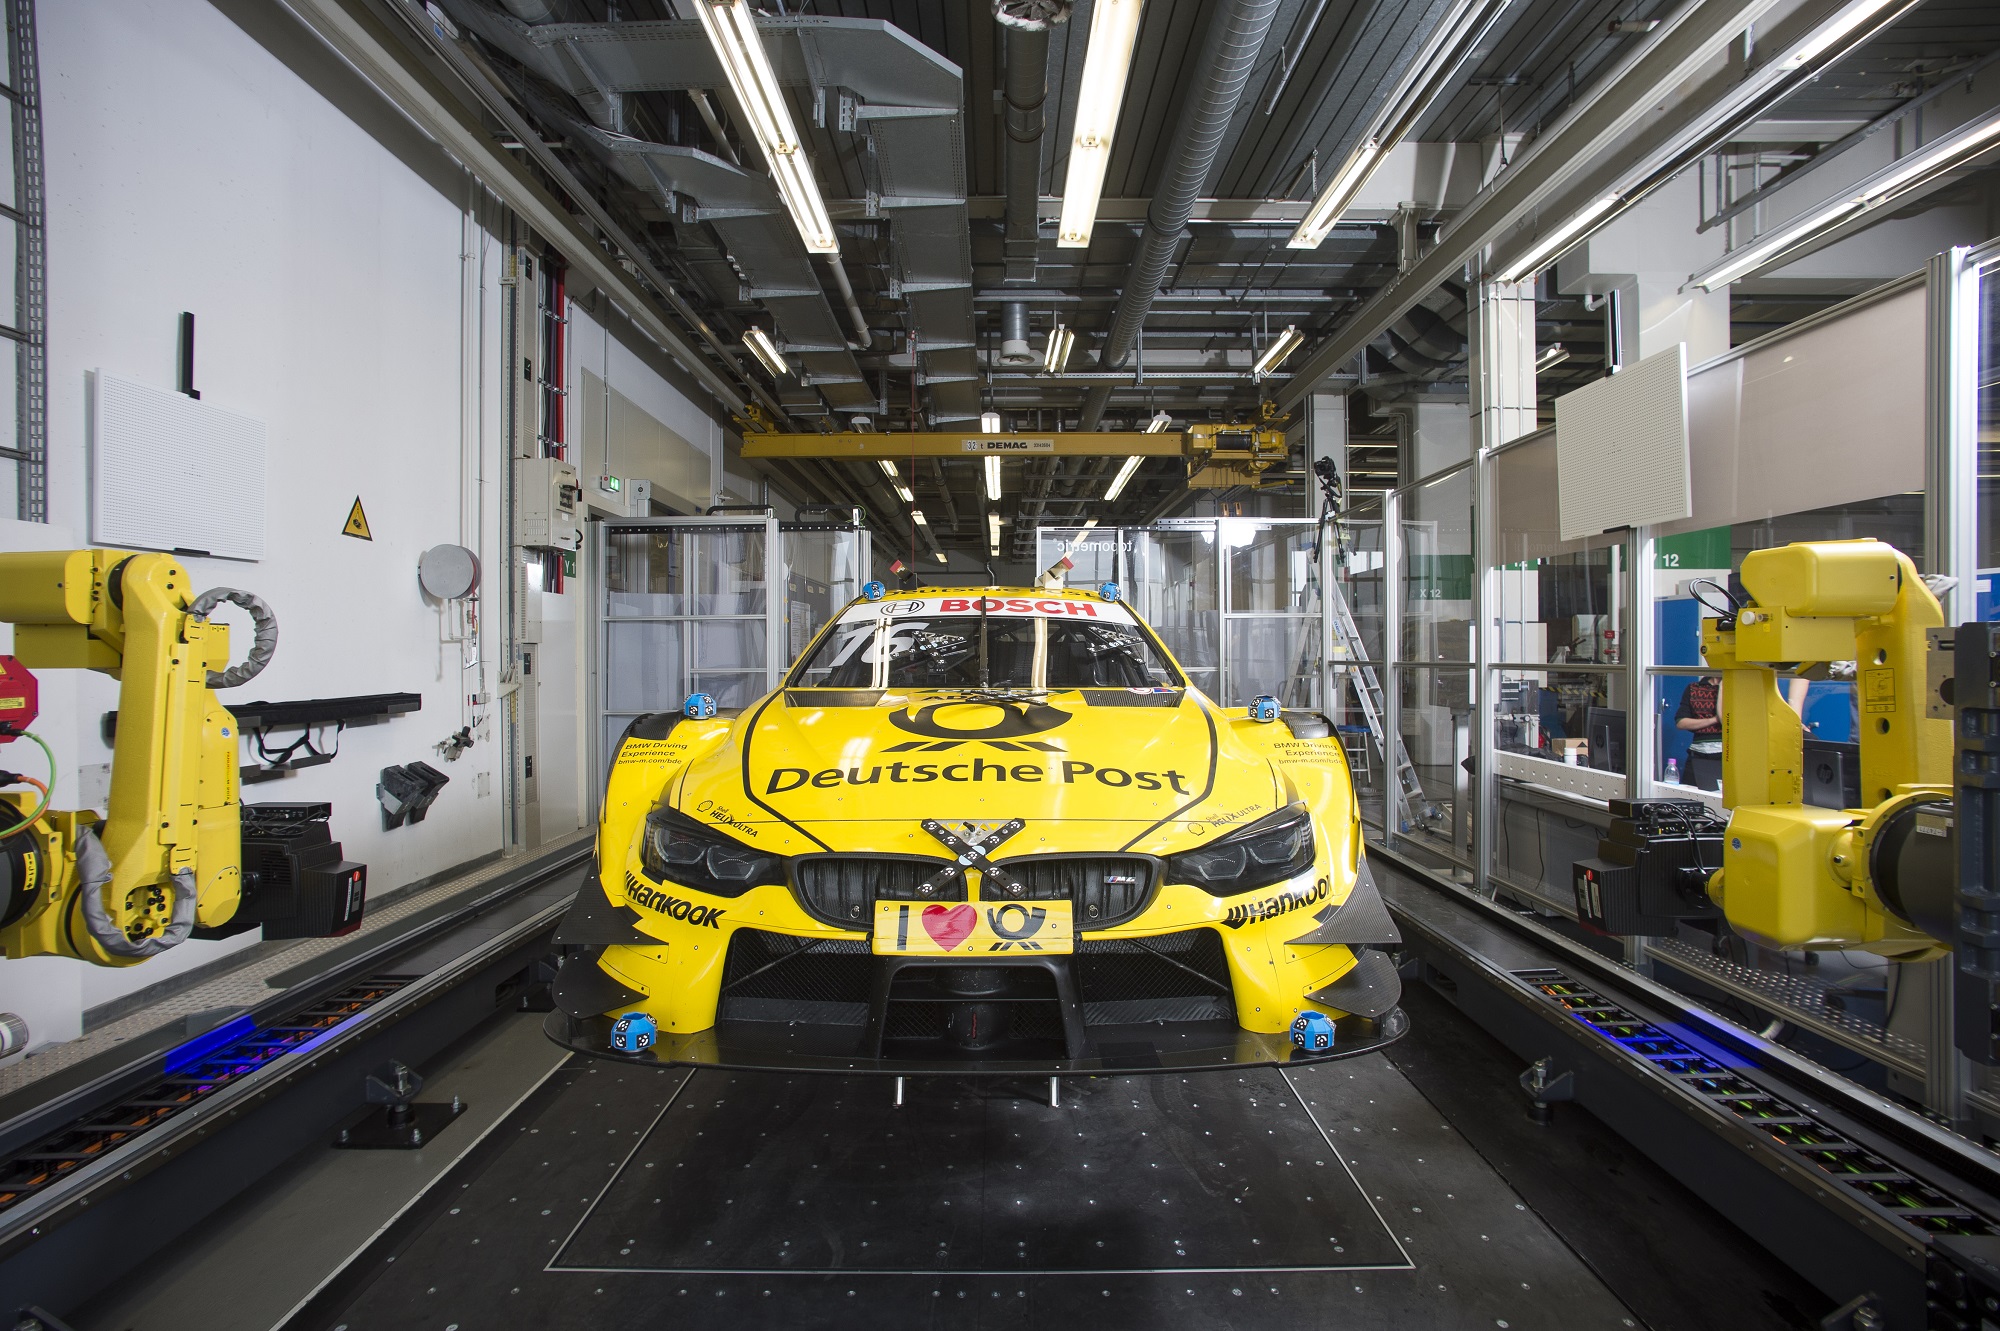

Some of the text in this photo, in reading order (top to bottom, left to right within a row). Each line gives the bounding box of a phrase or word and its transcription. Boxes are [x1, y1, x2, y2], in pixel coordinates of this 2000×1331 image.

[565, 560, 570, 573] Y
[1662, 553, 1680, 567] 12
[1420, 589, 1441, 598] X 12
[939, 599, 1098, 617] BOSCH
[828, 622, 930, 668] 16
[625, 742, 688, 750] BMW Driving
[1302, 742, 1338, 750] Driving
[621, 749, 676, 758] Experience
[1285, 749, 1340, 757] Experience
[766, 758, 1190, 795] Deutsche Post
[1211, 803, 1262, 828] HELIX ULTRA
[709, 810, 758, 838] HELIX ULTRA
